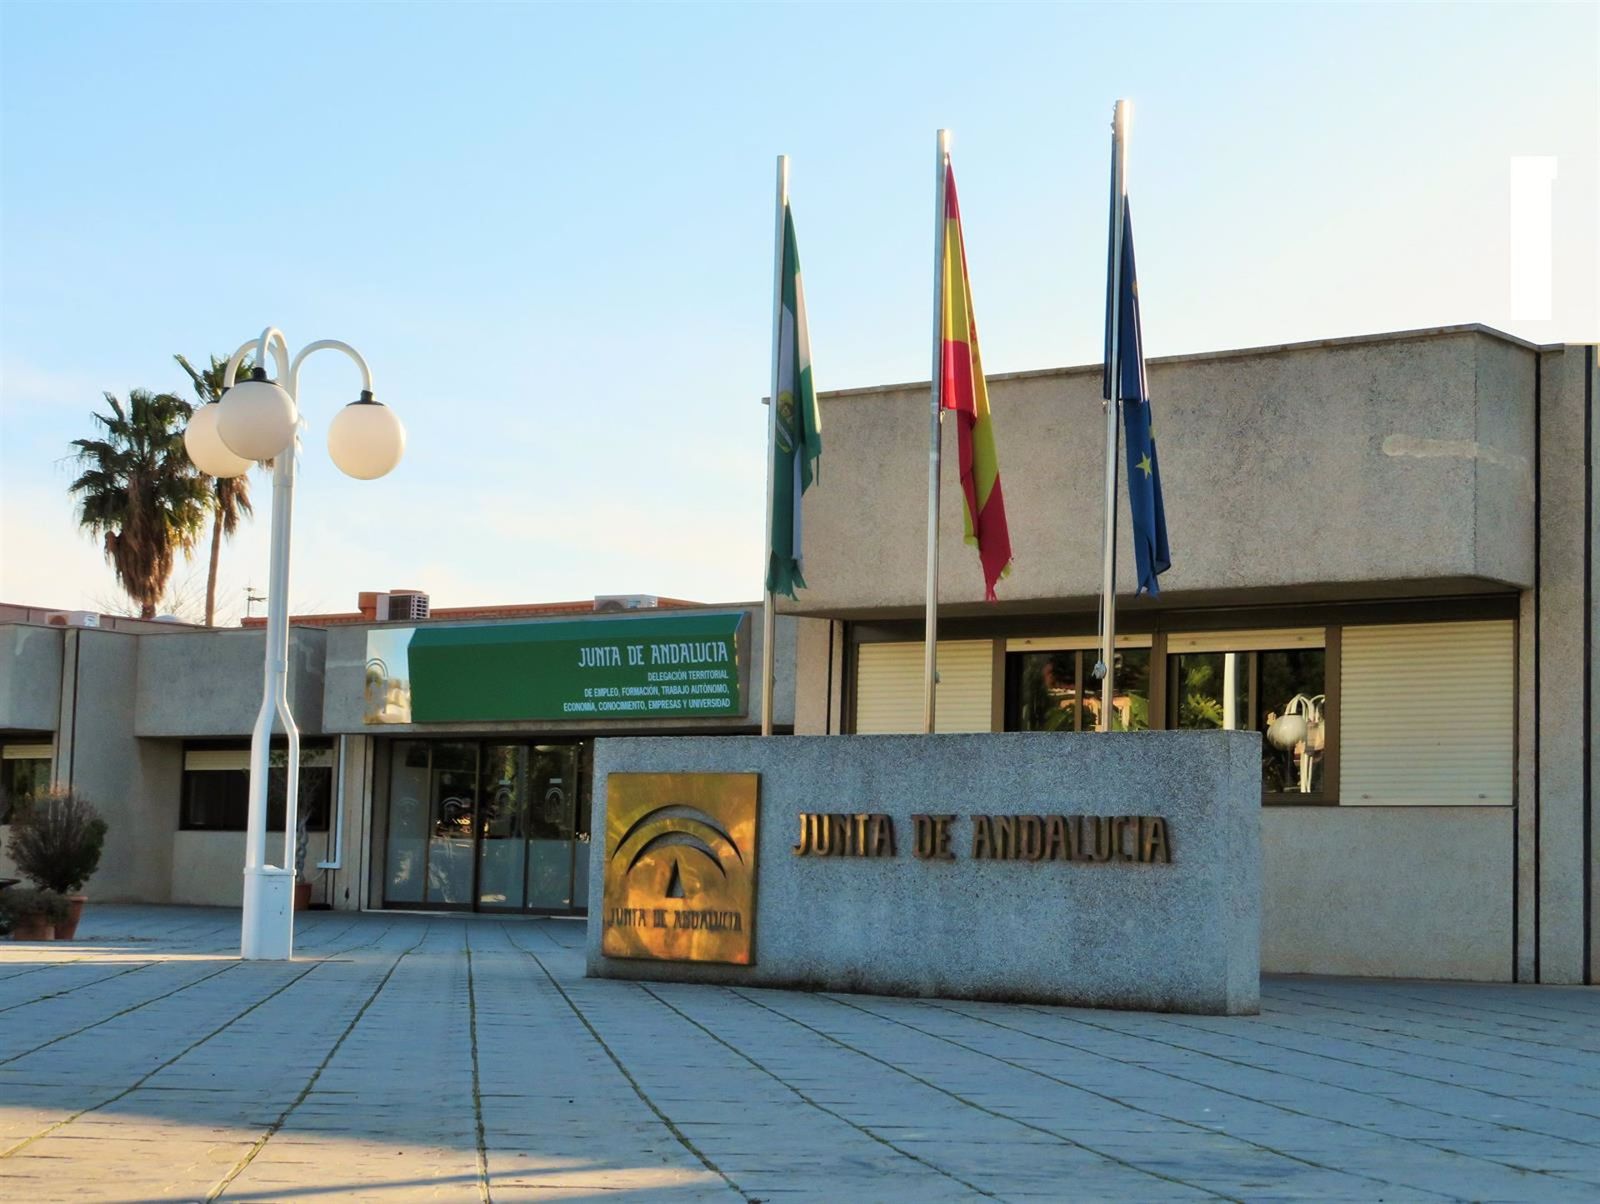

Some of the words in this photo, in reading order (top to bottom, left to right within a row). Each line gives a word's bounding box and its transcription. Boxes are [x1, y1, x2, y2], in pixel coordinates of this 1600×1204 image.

[578, 646, 621, 667] JUNTA
[627, 645, 645, 666] DE
[651, 641, 728, 664] ANDALUCIA
[647, 670, 687, 682] DELEGACIÓN
[688, 670, 729, 680] TERRITORIAL
[584, 688, 593, 698] DE
[594, 687, 621, 698] EMPLEO,
[622, 685, 660, 697] FORMACIÓN,
[662, 685, 690, 695] TRABAJO
[598, 701, 647, 711] CONOCIMIENTO,
[648, 699, 682, 710] EMPRESAS
[688, 698, 731, 708] UNIVERSIDAD
[793, 812, 897, 857] JUNTA
[911, 814, 957, 862] DE
[970, 814, 1172, 863] ANDALUCIA
[607, 908, 647, 928] JUNTA
[652, 909, 668, 929] DE
[673, 910, 742, 932] ANDALUCIA
